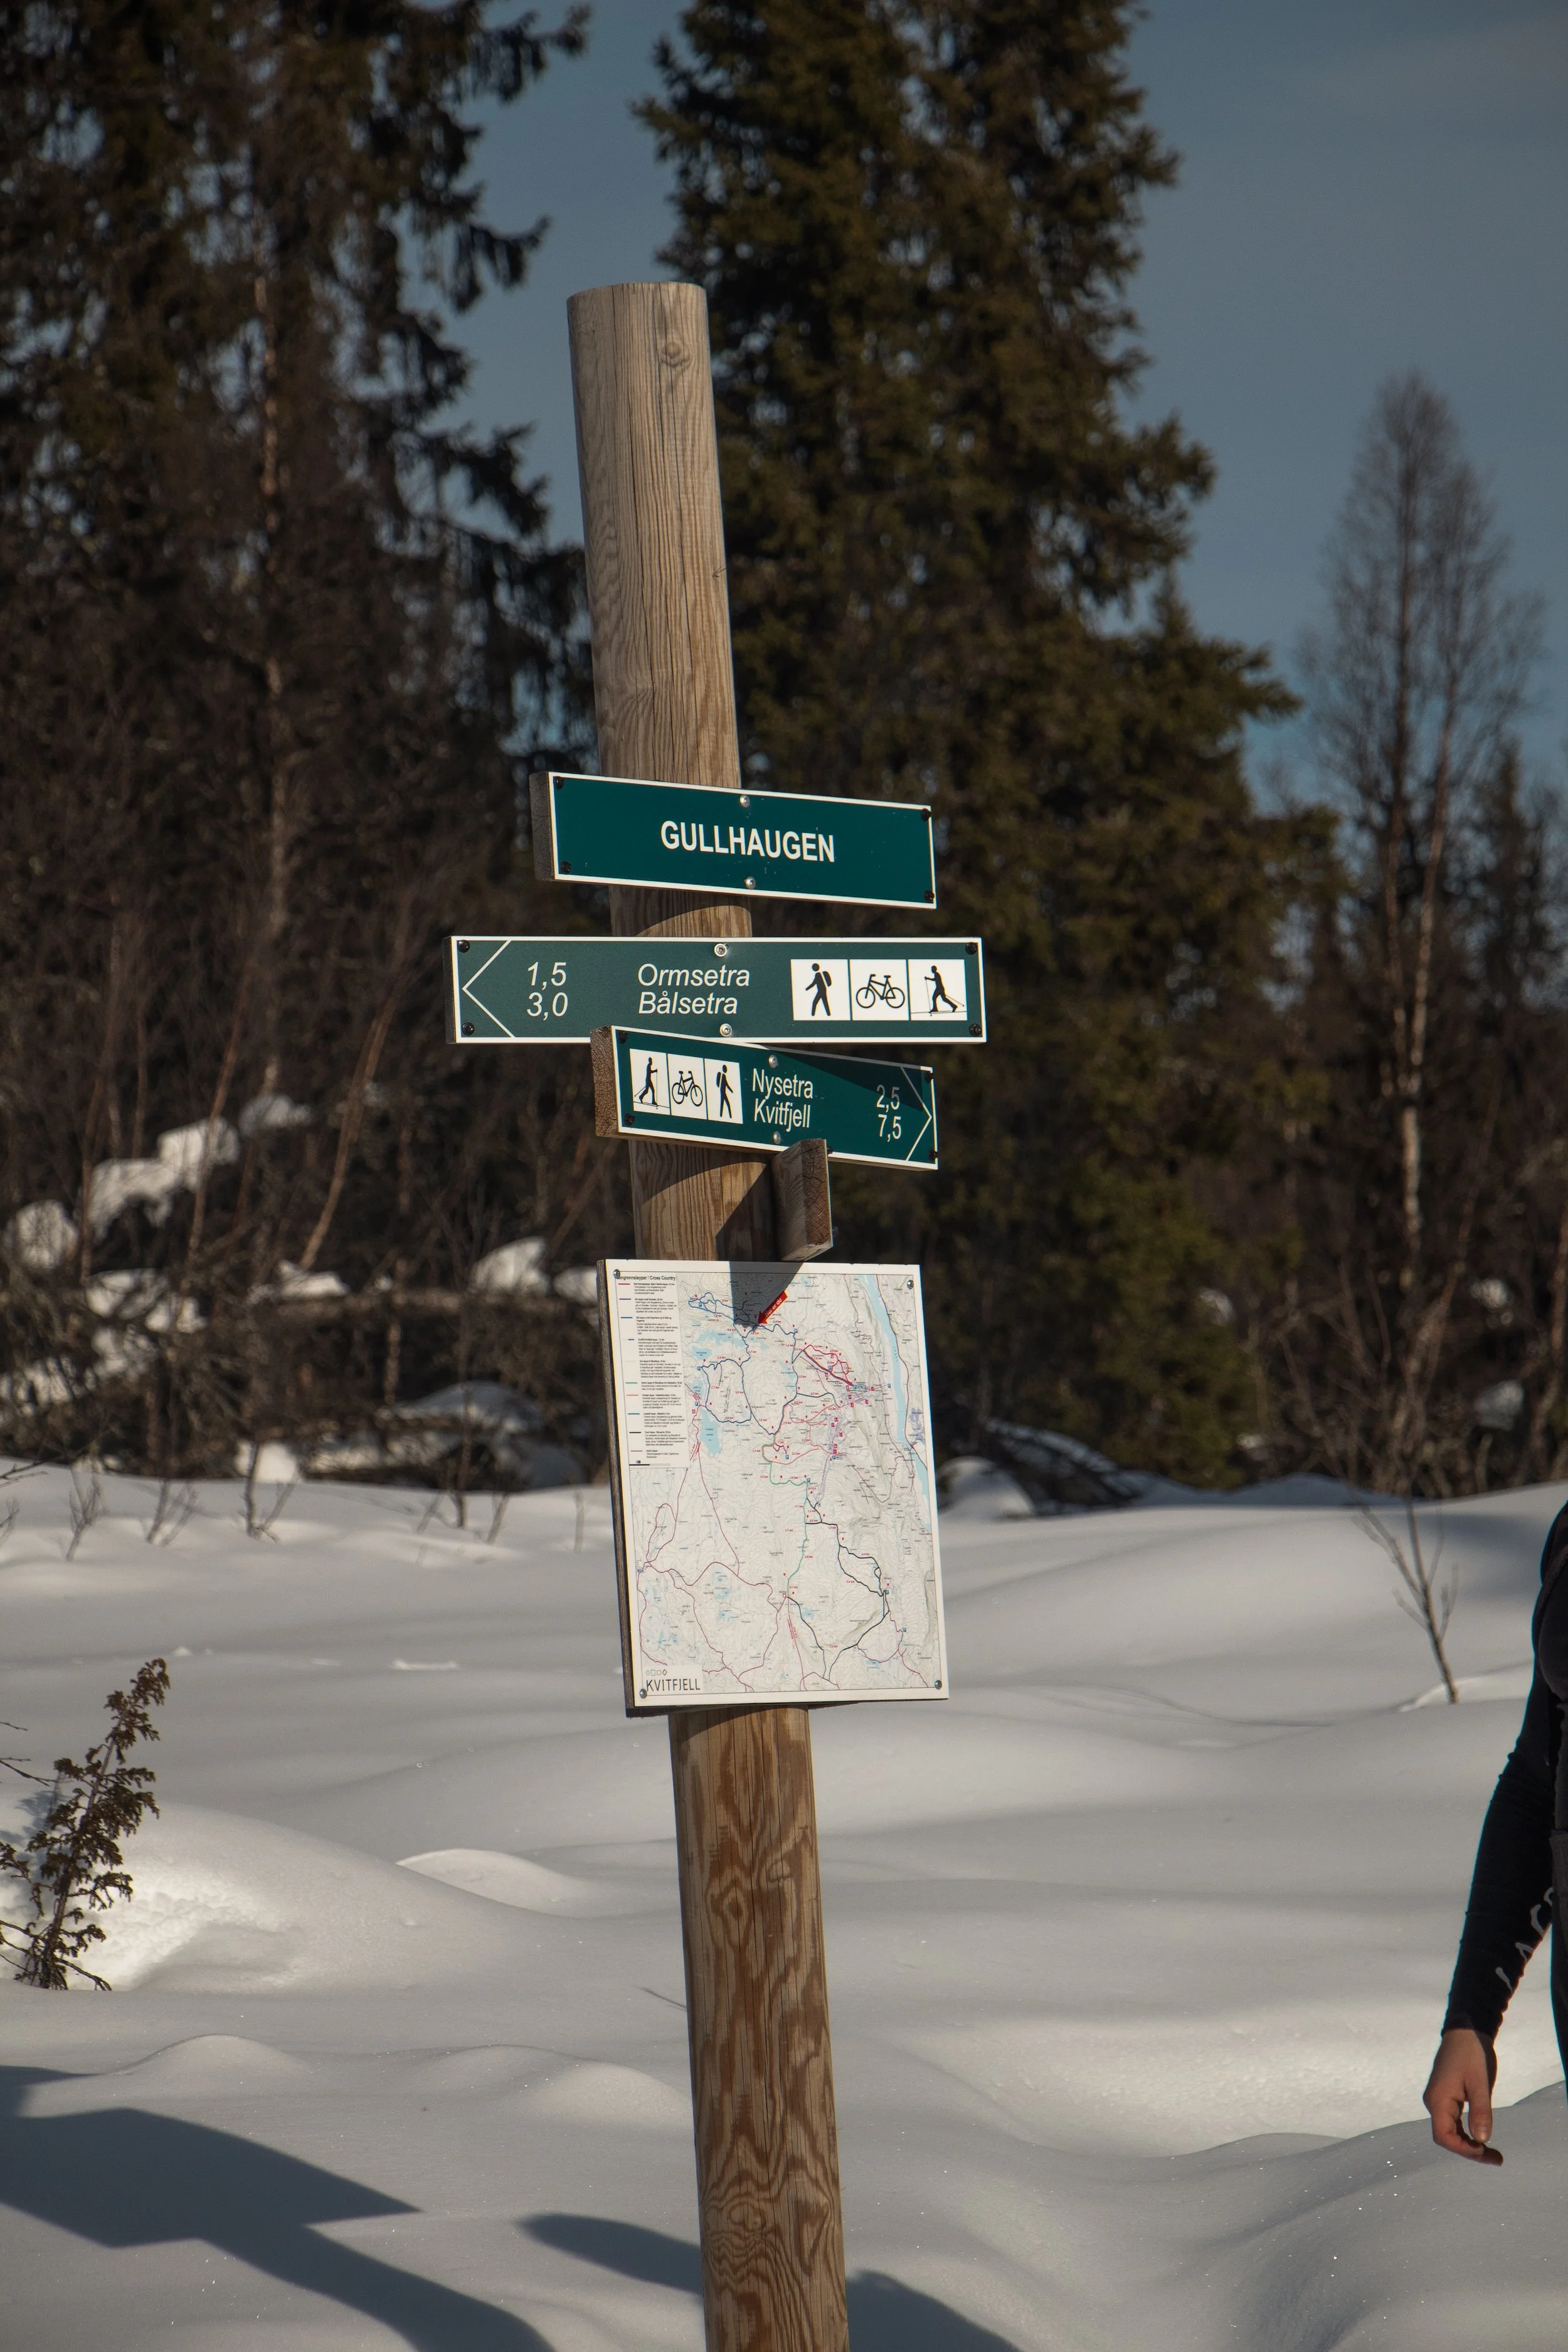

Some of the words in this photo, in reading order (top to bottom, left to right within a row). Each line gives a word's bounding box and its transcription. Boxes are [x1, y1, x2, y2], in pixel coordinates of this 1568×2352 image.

[660, 820, 835, 863] GULLHAUGEN
[527, 961, 566, 990] 1,5
[638, 963, 750, 987] Ormsetra
[527, 992, 568, 1020] 3,0
[638, 990, 738, 1015] Bålsetra
[752, 1068, 813, 1100] Nysetra
[876, 1084, 900, 1113] 2,5
[754, 1098, 811, 1132] Kvitfjell
[878, 1114, 902, 1143] 7,5
[646, 1678, 701, 1692] KVITFJELL
